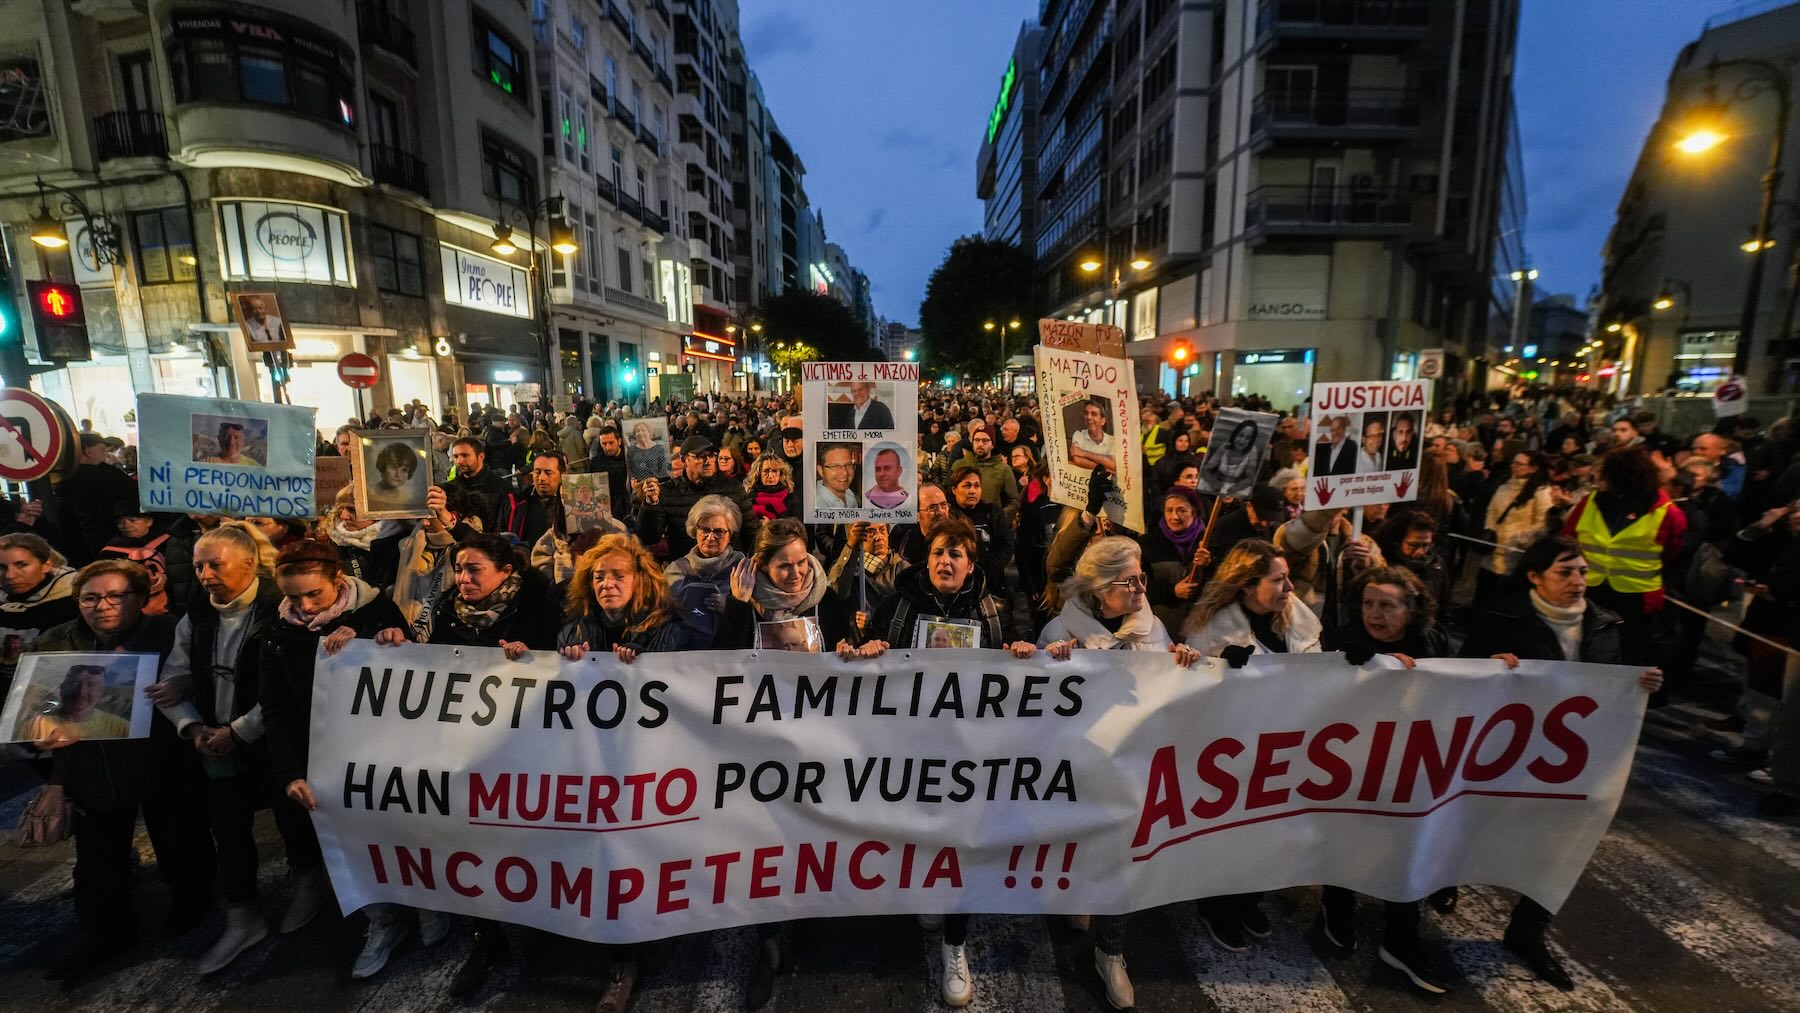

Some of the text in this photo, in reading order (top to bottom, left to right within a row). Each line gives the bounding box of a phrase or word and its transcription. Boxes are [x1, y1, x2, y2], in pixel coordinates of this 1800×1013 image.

[177, 19, 222, 29] VIVIENDAS
[461, 256, 486, 275] Inmo
[468, 277, 512, 308] PEOPLE
[857, 364, 869, 380] de
[874, 362, 919, 381] MAZON
[1049, 356, 1117, 384] MATADO
[1318, 384, 1425, 411] JUSTICIA
[864, 430, 884, 440] MORA
[185, 466, 314, 495] PERDONAMOS
[1339, 475, 1352, 485] por
[1354, 474, 1365, 483] mi
[1366, 485, 1385, 496] hijos
[838, 511, 861, 519] MORA
[895, 510, 913, 519] MORA
[350, 666, 1087, 730] NUESTROS FAMILIARES
[1130, 695, 1600, 848] ASESINOS
[343, 756, 1078, 824] HAN MUERTO POR VUESTRA
[366, 840, 1078, 921] INCOMPETENCIA !!!
